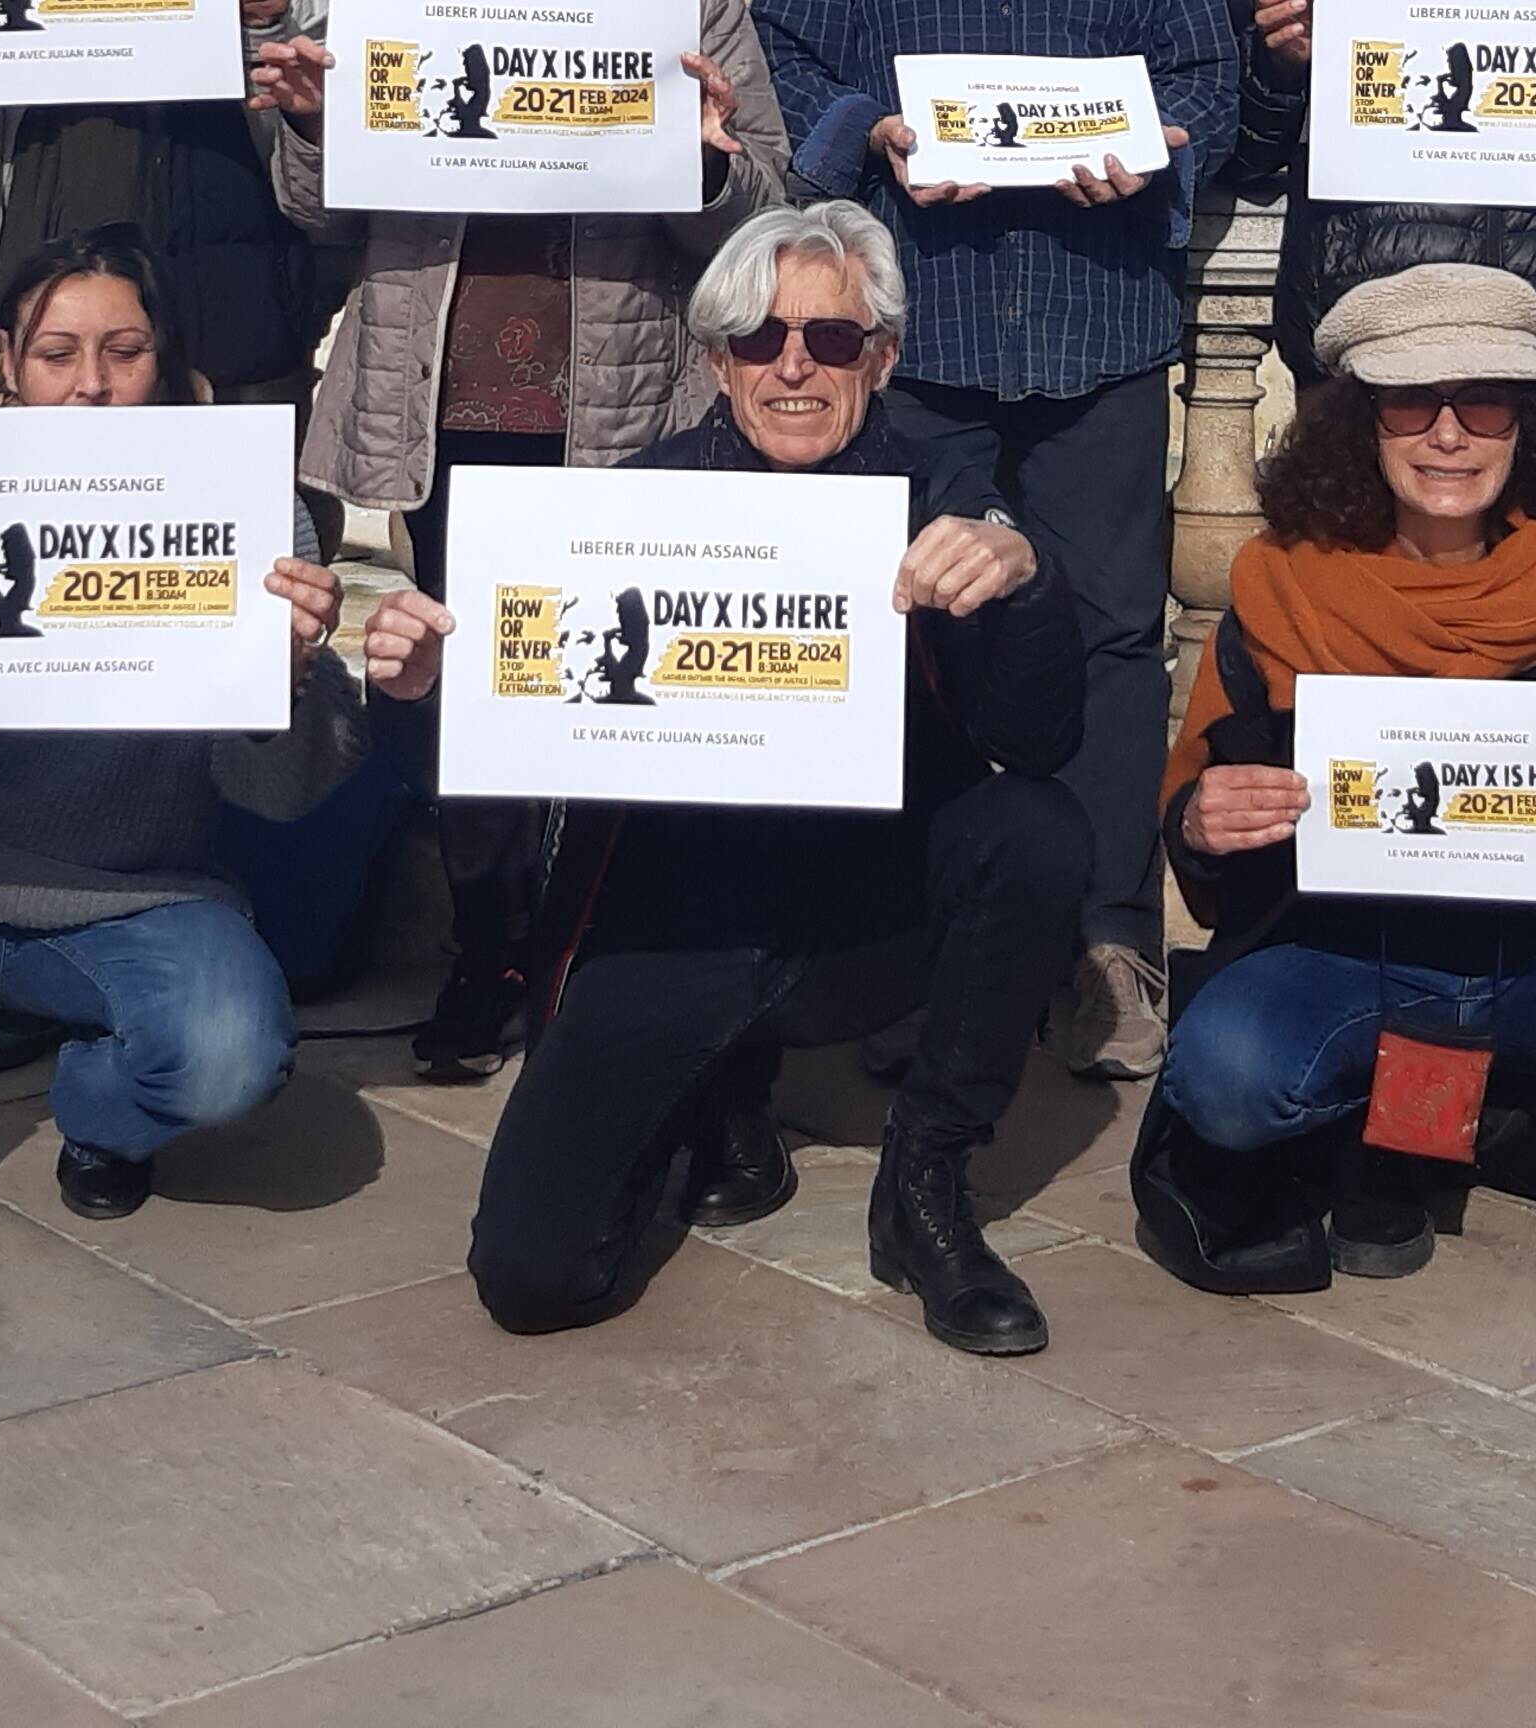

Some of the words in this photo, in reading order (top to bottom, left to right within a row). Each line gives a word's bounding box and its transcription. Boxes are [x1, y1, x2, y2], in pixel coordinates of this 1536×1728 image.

[493, 46, 539, 77] DAY
[542, 49, 558, 78] X
[565, 50, 587, 79] IS
[593, 51, 653, 80] HERE
[1475, 45, 1520, 73] DAY
[513, 86, 575, 114] 20-21
[579, 89, 607, 104] FEB
[611, 90, 649, 106] 2024
[1016, 103, 1049, 117] DAY
[1050, 104, 1062, 118] X
[1063, 102, 1081, 118] IS
[1083, 99, 1126, 116] HERE
[1033, 121, 1076, 134] 20-21
[23, 479, 82, 493] JULIAN
[87, 478, 165, 493] ASSANGE
[39, 524, 96, 561] DAY
[100, 525, 120, 560] X
[128, 524, 156, 559] IS
[163, 523, 236, 558] HERE
[570, 540, 634, 555] LIBERER
[639, 542, 696, 558] JULIAN
[701, 545, 778, 561] ASSANGE
[63, 570, 141, 603] 20-21
[146, 570, 179, 588] FEB
[185, 568, 231, 587] 2024
[501, 599, 543, 618] NOW
[653, 590, 709, 627] DAY
[713, 593, 733, 628] X
[741, 594, 768, 629] IS
[775, 594, 849, 630] HERE
[500, 619, 524, 638] OR
[500, 640, 552, 659] NEVER
[676, 640, 753, 672] 20-21
[758, 642, 792, 660] FEB
[797, 643, 843, 662] 2024
[1441, 762, 1481, 786] DAY
[1484, 764, 1498, 787] X
[1504, 764, 1523, 787] IS
[1459, 794, 1513, 814] 20-21
